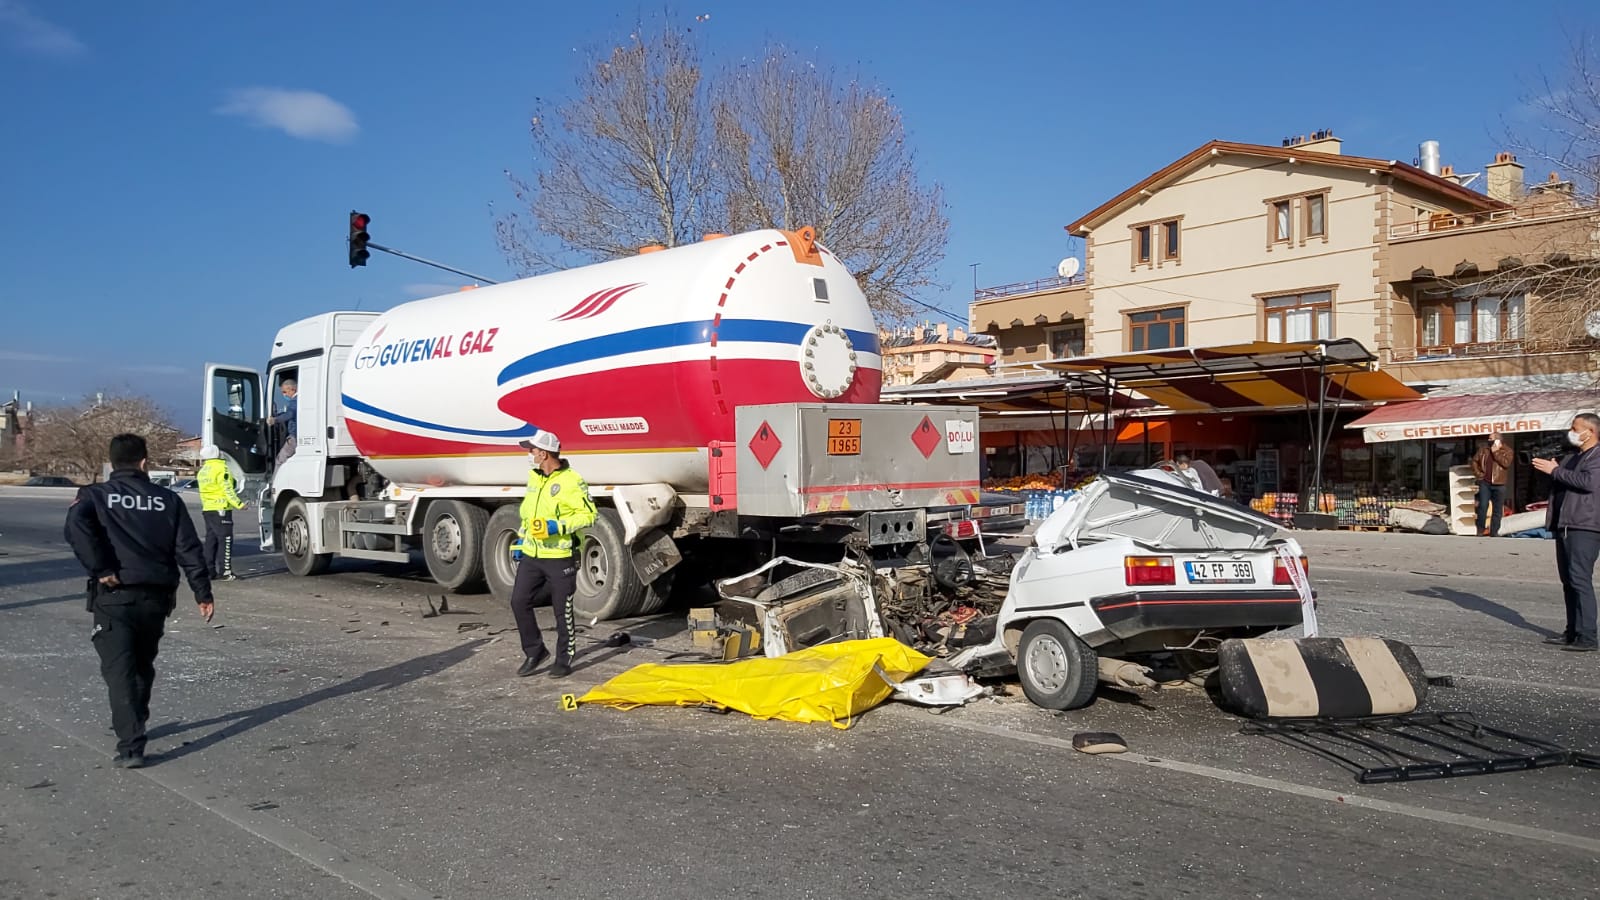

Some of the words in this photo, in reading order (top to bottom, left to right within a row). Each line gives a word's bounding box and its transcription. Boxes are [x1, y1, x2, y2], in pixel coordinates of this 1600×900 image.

[380, 335, 453, 366] GÜVENAL
[459, 327, 499, 356] GAZ
[619, 421, 645, 431] MADDE
[839, 421, 852, 435] 23
[948, 431, 972, 442] DOLU
[832, 439, 857, 453] 1965
[532, 519, 543, 532] 9
[1194, 563, 1208, 578] 42
[1211, 563, 1224, 578] FP
[1232, 563, 1251, 578] 369
[564, 695, 575, 709] 2
